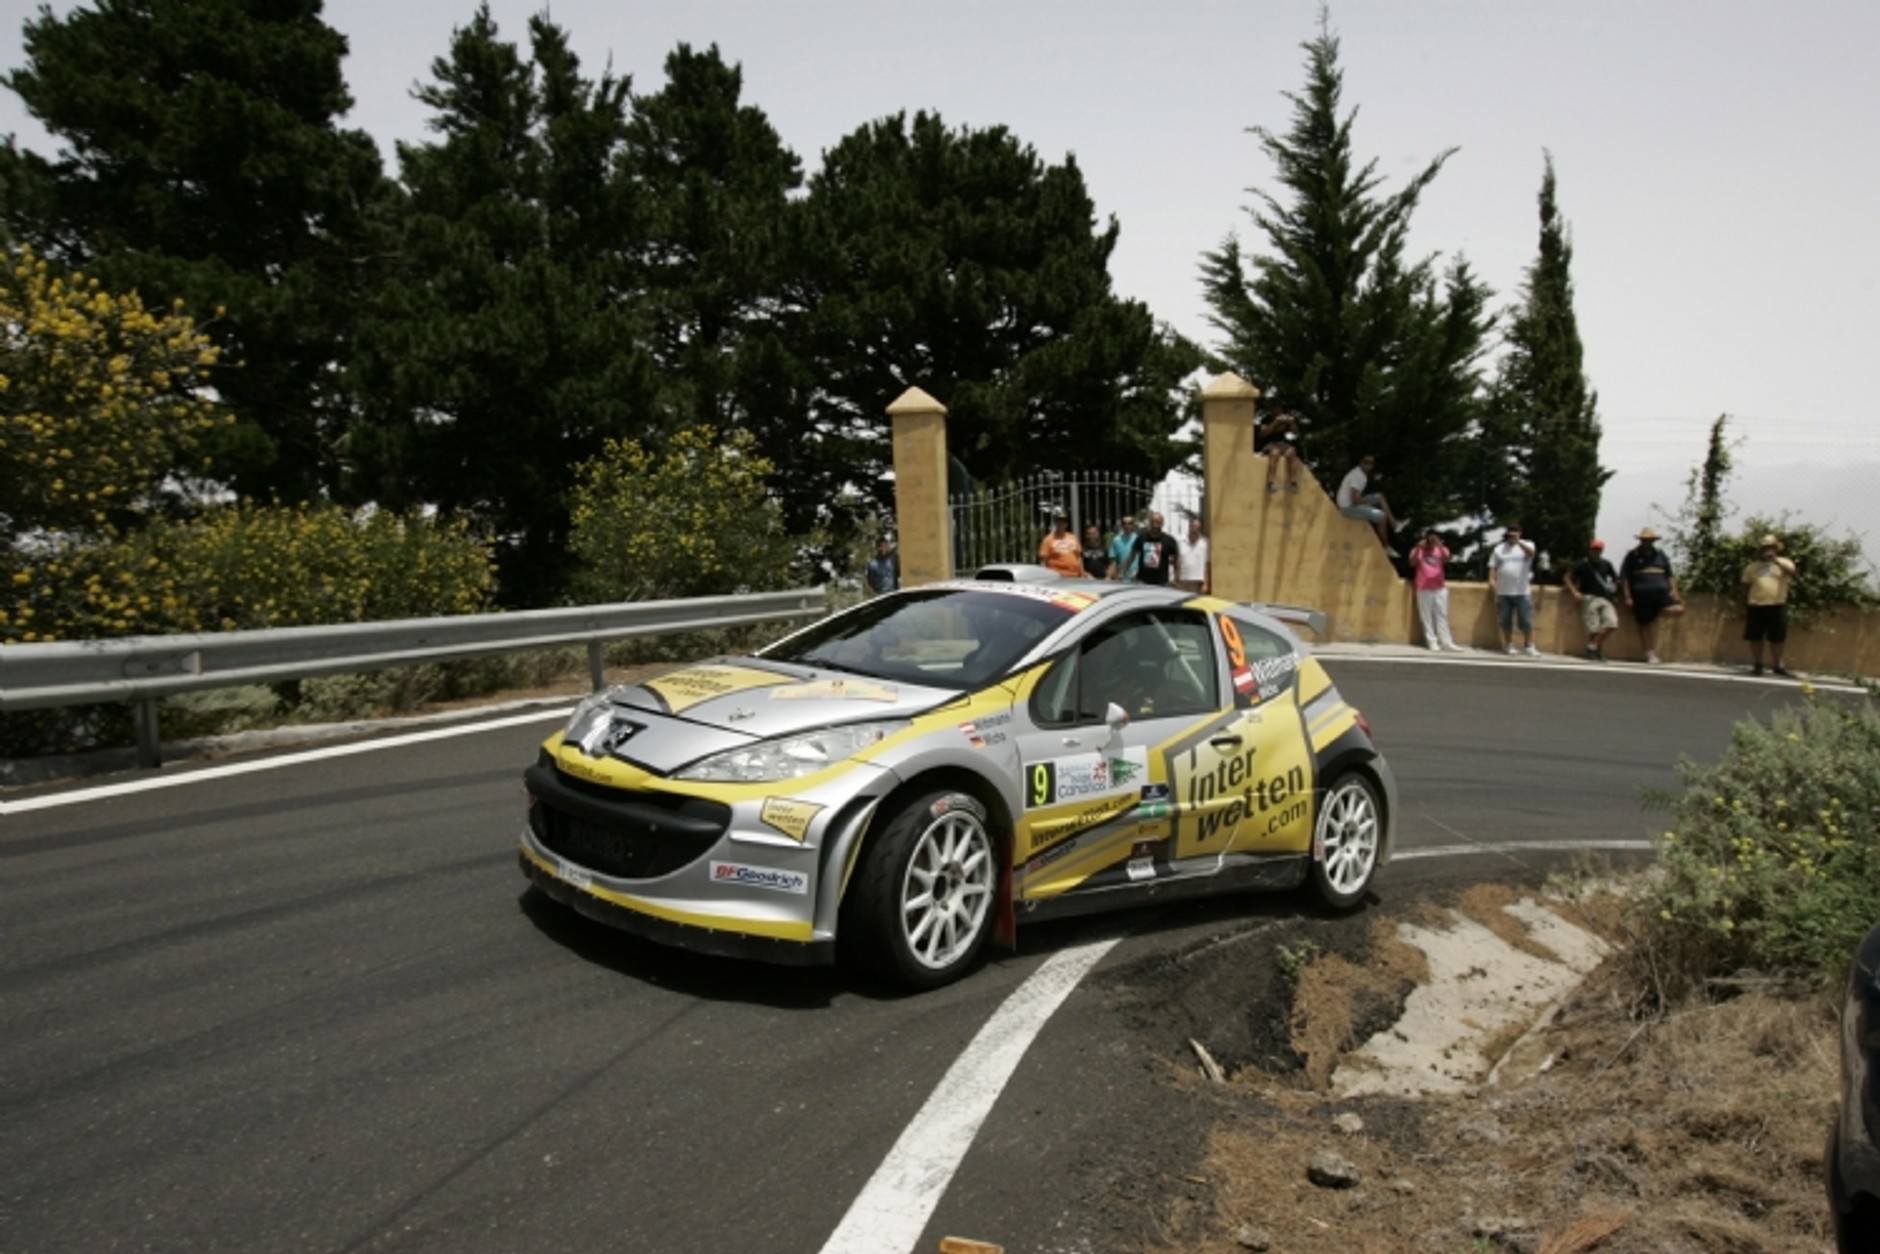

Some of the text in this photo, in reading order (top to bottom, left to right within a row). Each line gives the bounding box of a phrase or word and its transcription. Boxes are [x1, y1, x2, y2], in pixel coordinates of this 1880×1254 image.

[1220, 613, 1245, 667] 9
[1034, 764, 1048, 806] 9
[1189, 747, 1256, 811] inter
[1197, 765, 1304, 841] wetten
[1261, 800, 1307, 838] .com
